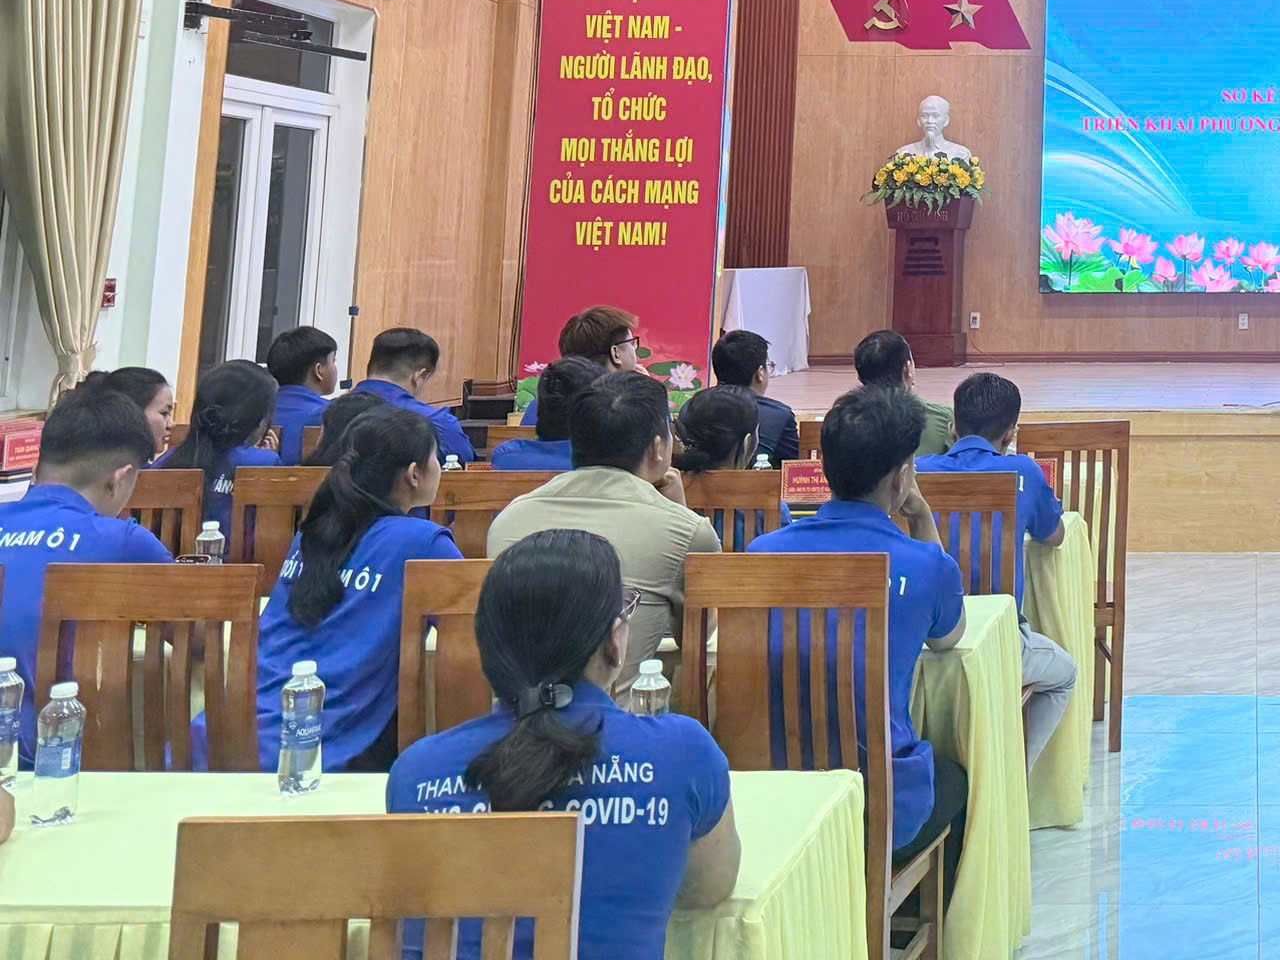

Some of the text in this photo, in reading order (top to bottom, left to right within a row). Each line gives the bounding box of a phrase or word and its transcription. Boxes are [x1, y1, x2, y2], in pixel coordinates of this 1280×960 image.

[586, 10, 623, 43] VIỆT
[628, 15, 670, 39] NAM
[560, 50, 713, 85] NGƯỜI LÃNH ĐẠO,
[592, 88, 667, 121] TỔ CHỨC
[1145, 116, 1195, 132] KHAI
[1200, 115, 1280, 133] PHƯƠNG
[560, 129, 693, 167] MỌI THẮNG LỢI
[549, 171, 699, 209] CỦA CÁCH MẠNG
[575, 216, 667, 251] VIỆT NAM!
[0, 527, 80, 551] NAM Ô 1
[355, 566, 370, 591] Ô
[371, 573, 383, 592] 1
[899, 576, 907, 596] 1
[592, 755, 654, 784] NẴNG
